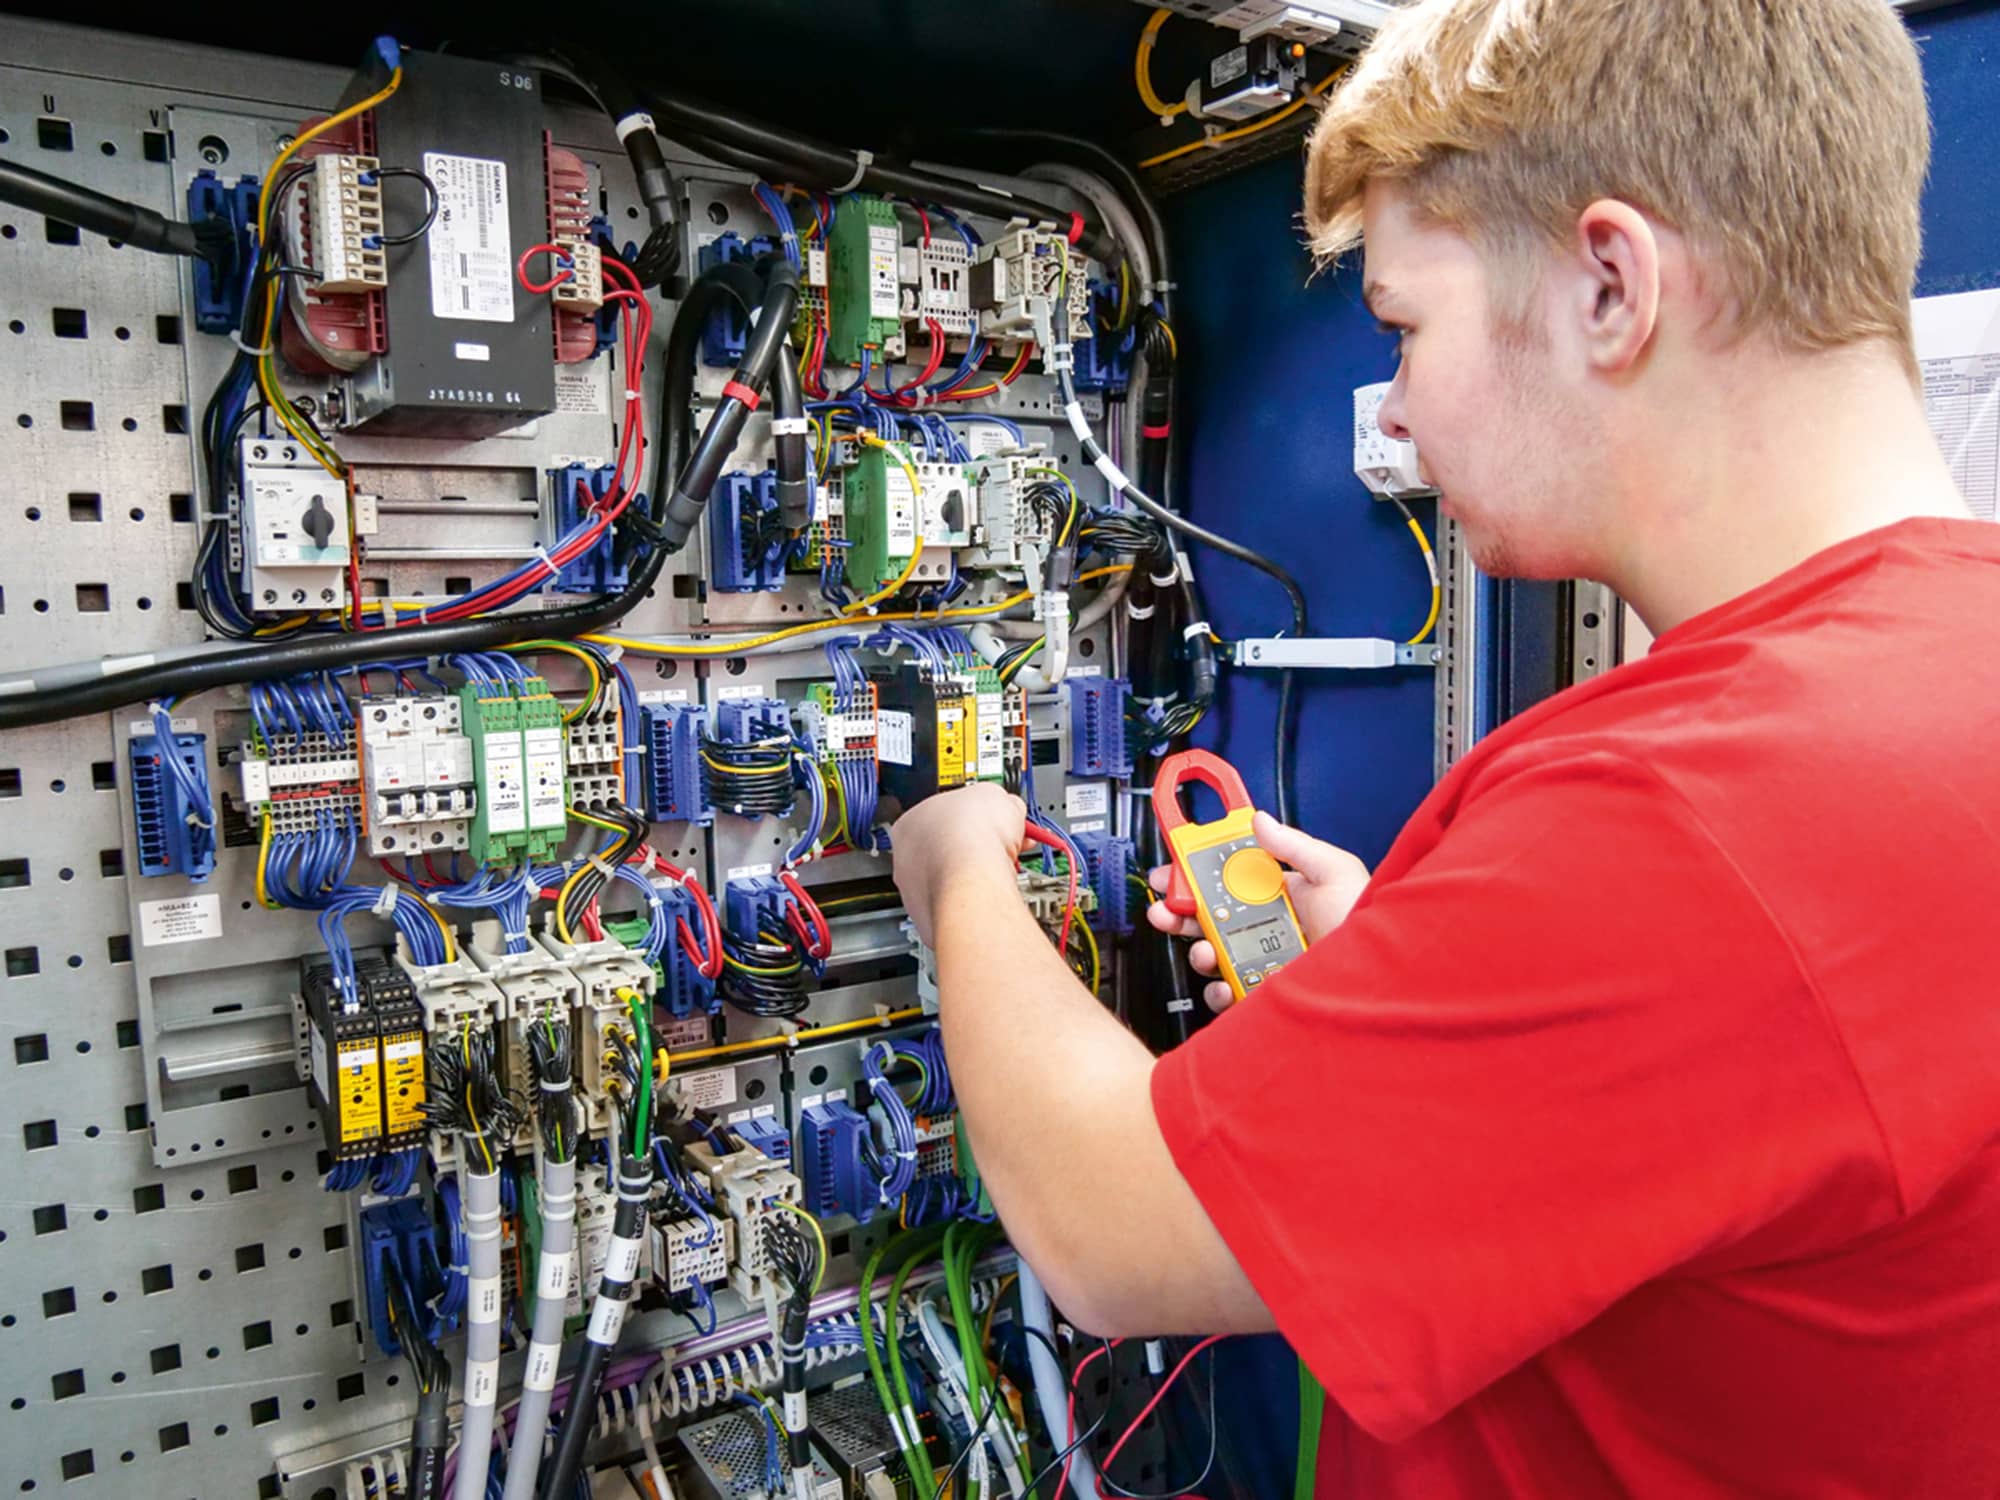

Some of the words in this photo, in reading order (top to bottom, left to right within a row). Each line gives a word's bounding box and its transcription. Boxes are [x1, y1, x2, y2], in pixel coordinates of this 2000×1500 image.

[499, 71, 511, 87] S
[514, 75, 533, 91] 06
[43, 95, 55, 114] U
[149, 109, 159, 127] V
[492, 164, 501, 204] SIEMENS
